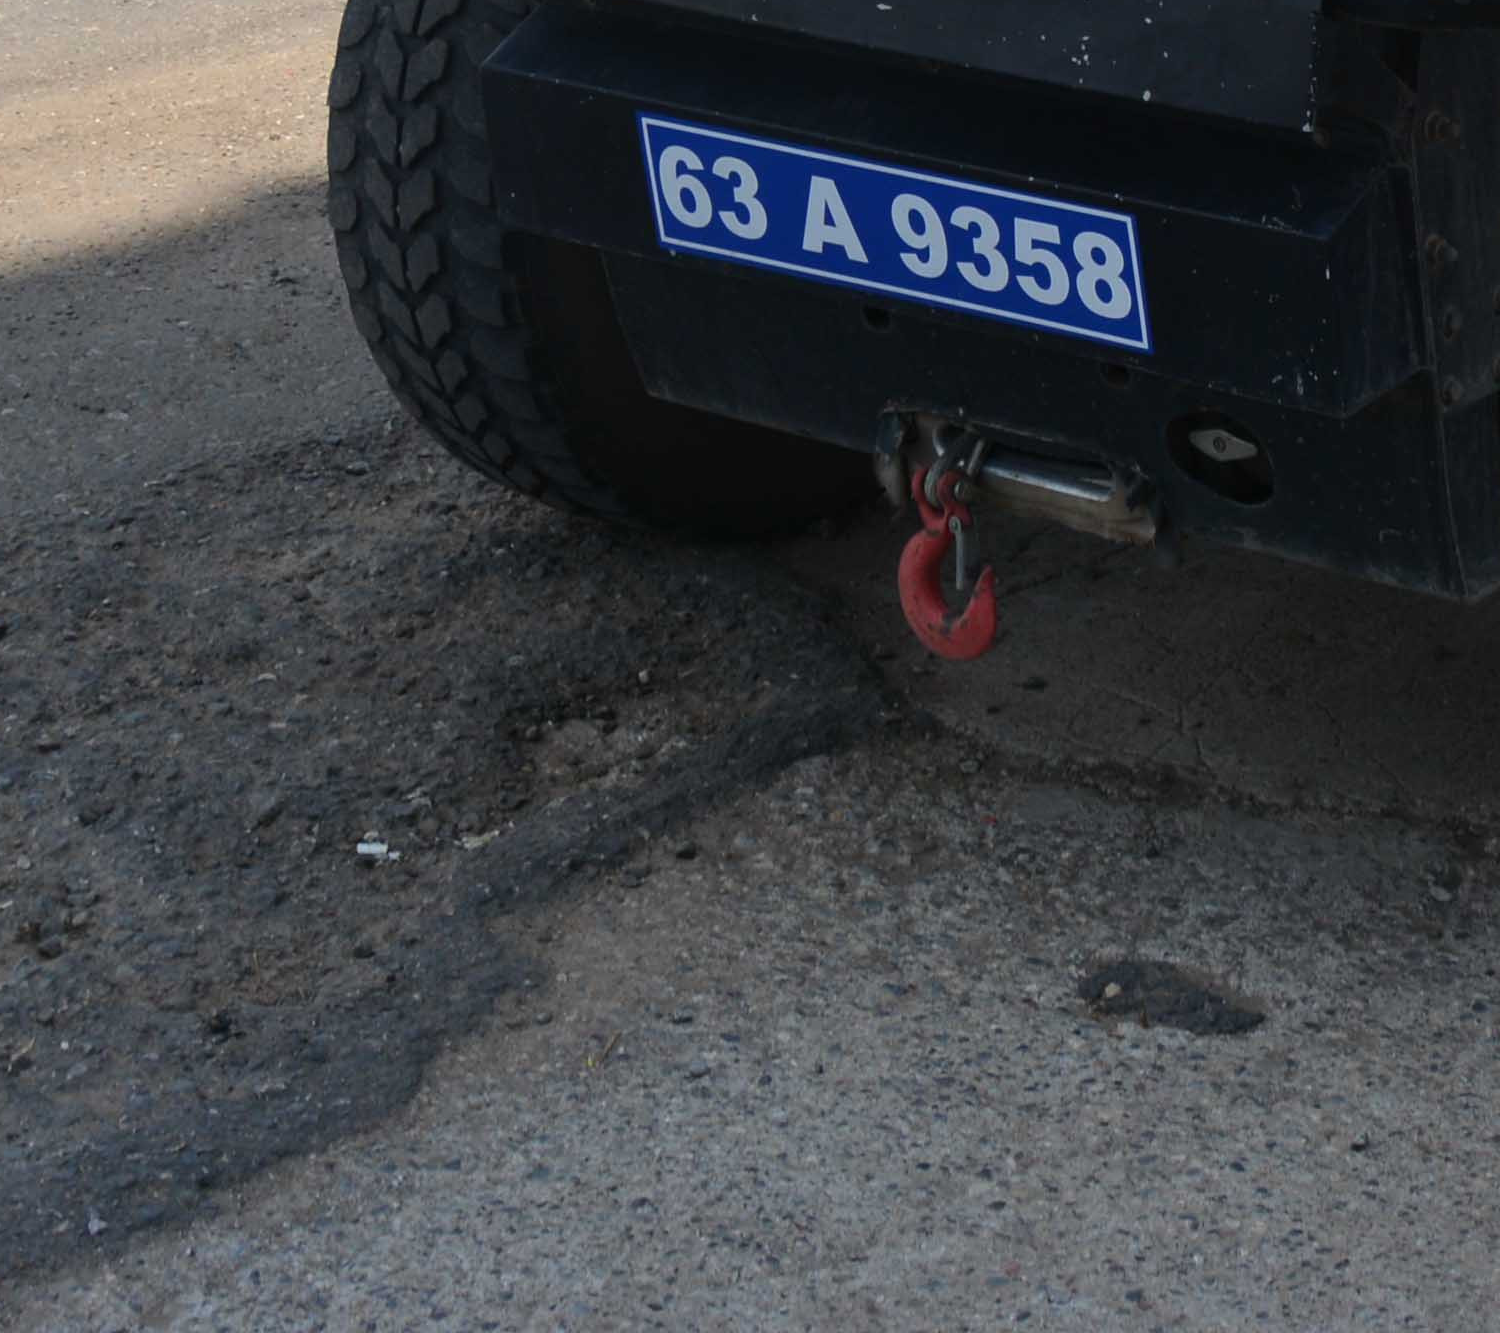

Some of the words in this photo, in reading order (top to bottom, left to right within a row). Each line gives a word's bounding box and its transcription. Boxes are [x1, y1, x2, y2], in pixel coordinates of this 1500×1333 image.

[658, 144, 768, 241] 63
[801, 175, 869, 264] A
[890, 193, 1133, 320] 9358
